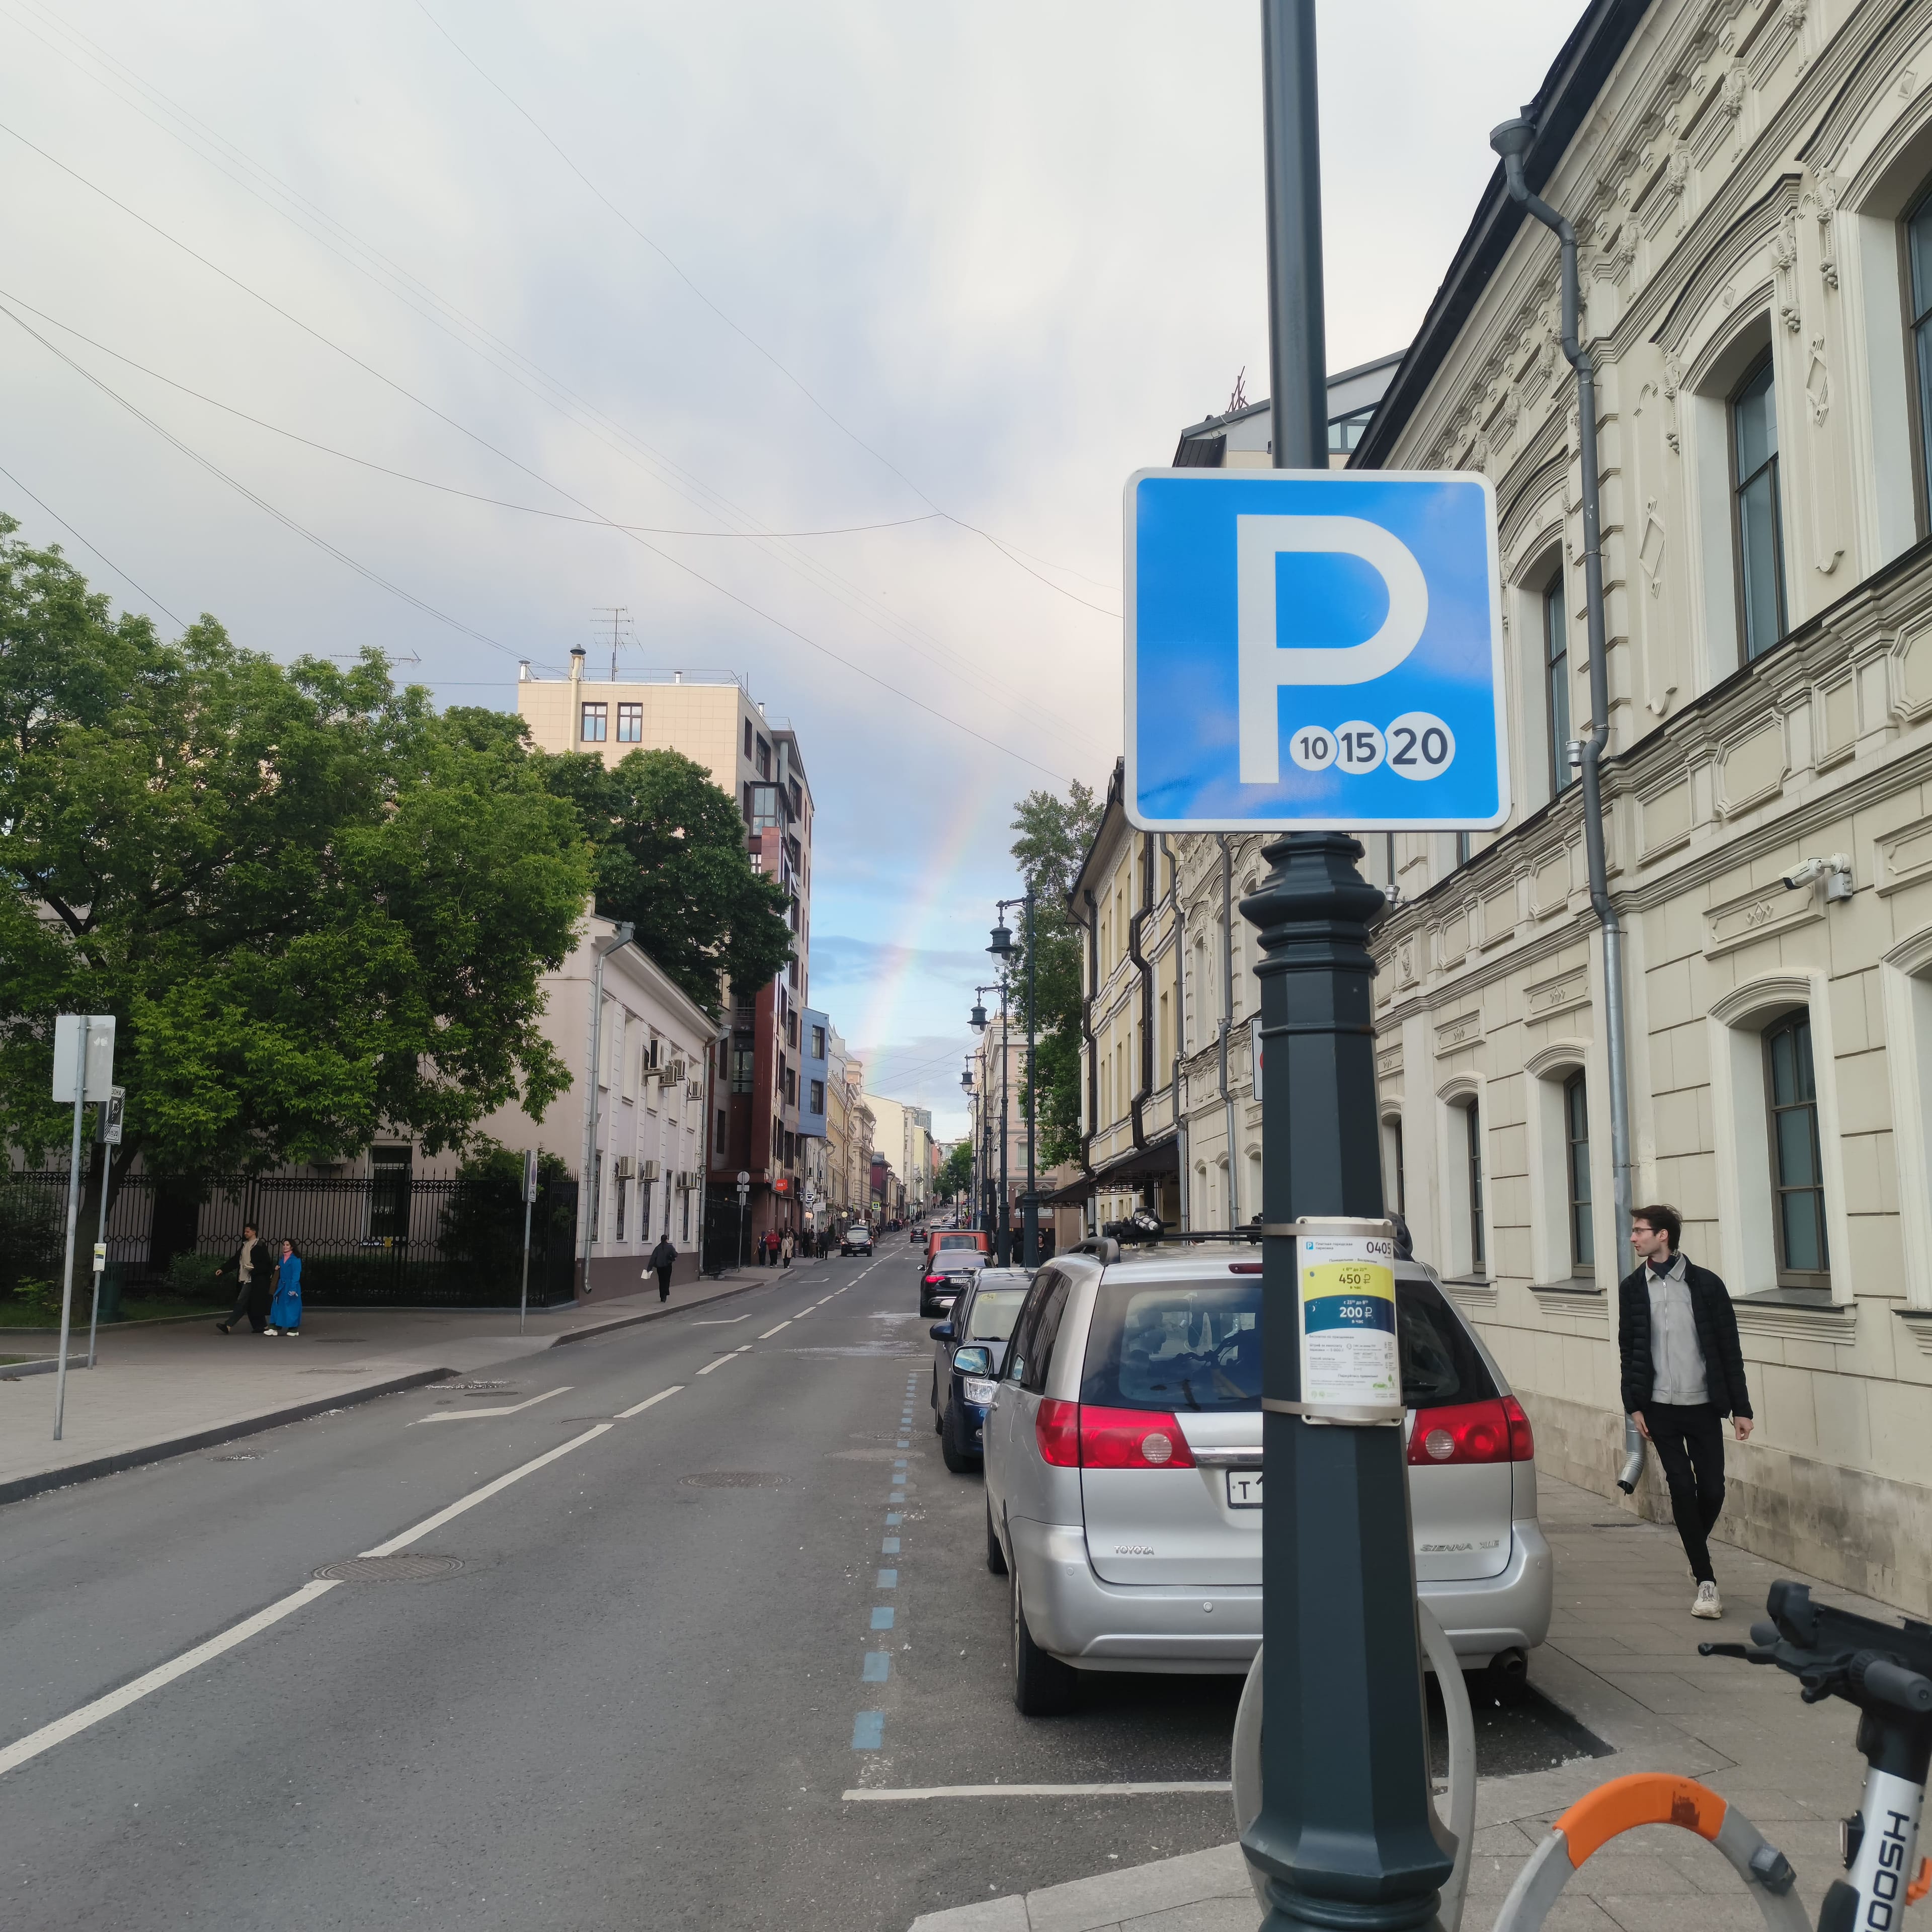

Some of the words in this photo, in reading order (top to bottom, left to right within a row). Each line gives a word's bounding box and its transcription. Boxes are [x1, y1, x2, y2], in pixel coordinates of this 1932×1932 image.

[1237, 514, 1428, 783] P
[1300, 736, 1328, 760] 10
[1341, 732, 1377, 763] 15
[1393, 727, 1448, 765] 20
[1366, 1241, 1392, 1255] 0405
[1339, 1273, 1361, 1284] 450
[1339, 1306, 1363, 1318] 200
[1114, 1545, 1155, 1555] TOYOTA
[1420, 1543, 1473, 1552] SIENNA
[1479, 1540, 1499, 1550] XLE
[1865, 1810, 1910, 1932] OOSH
